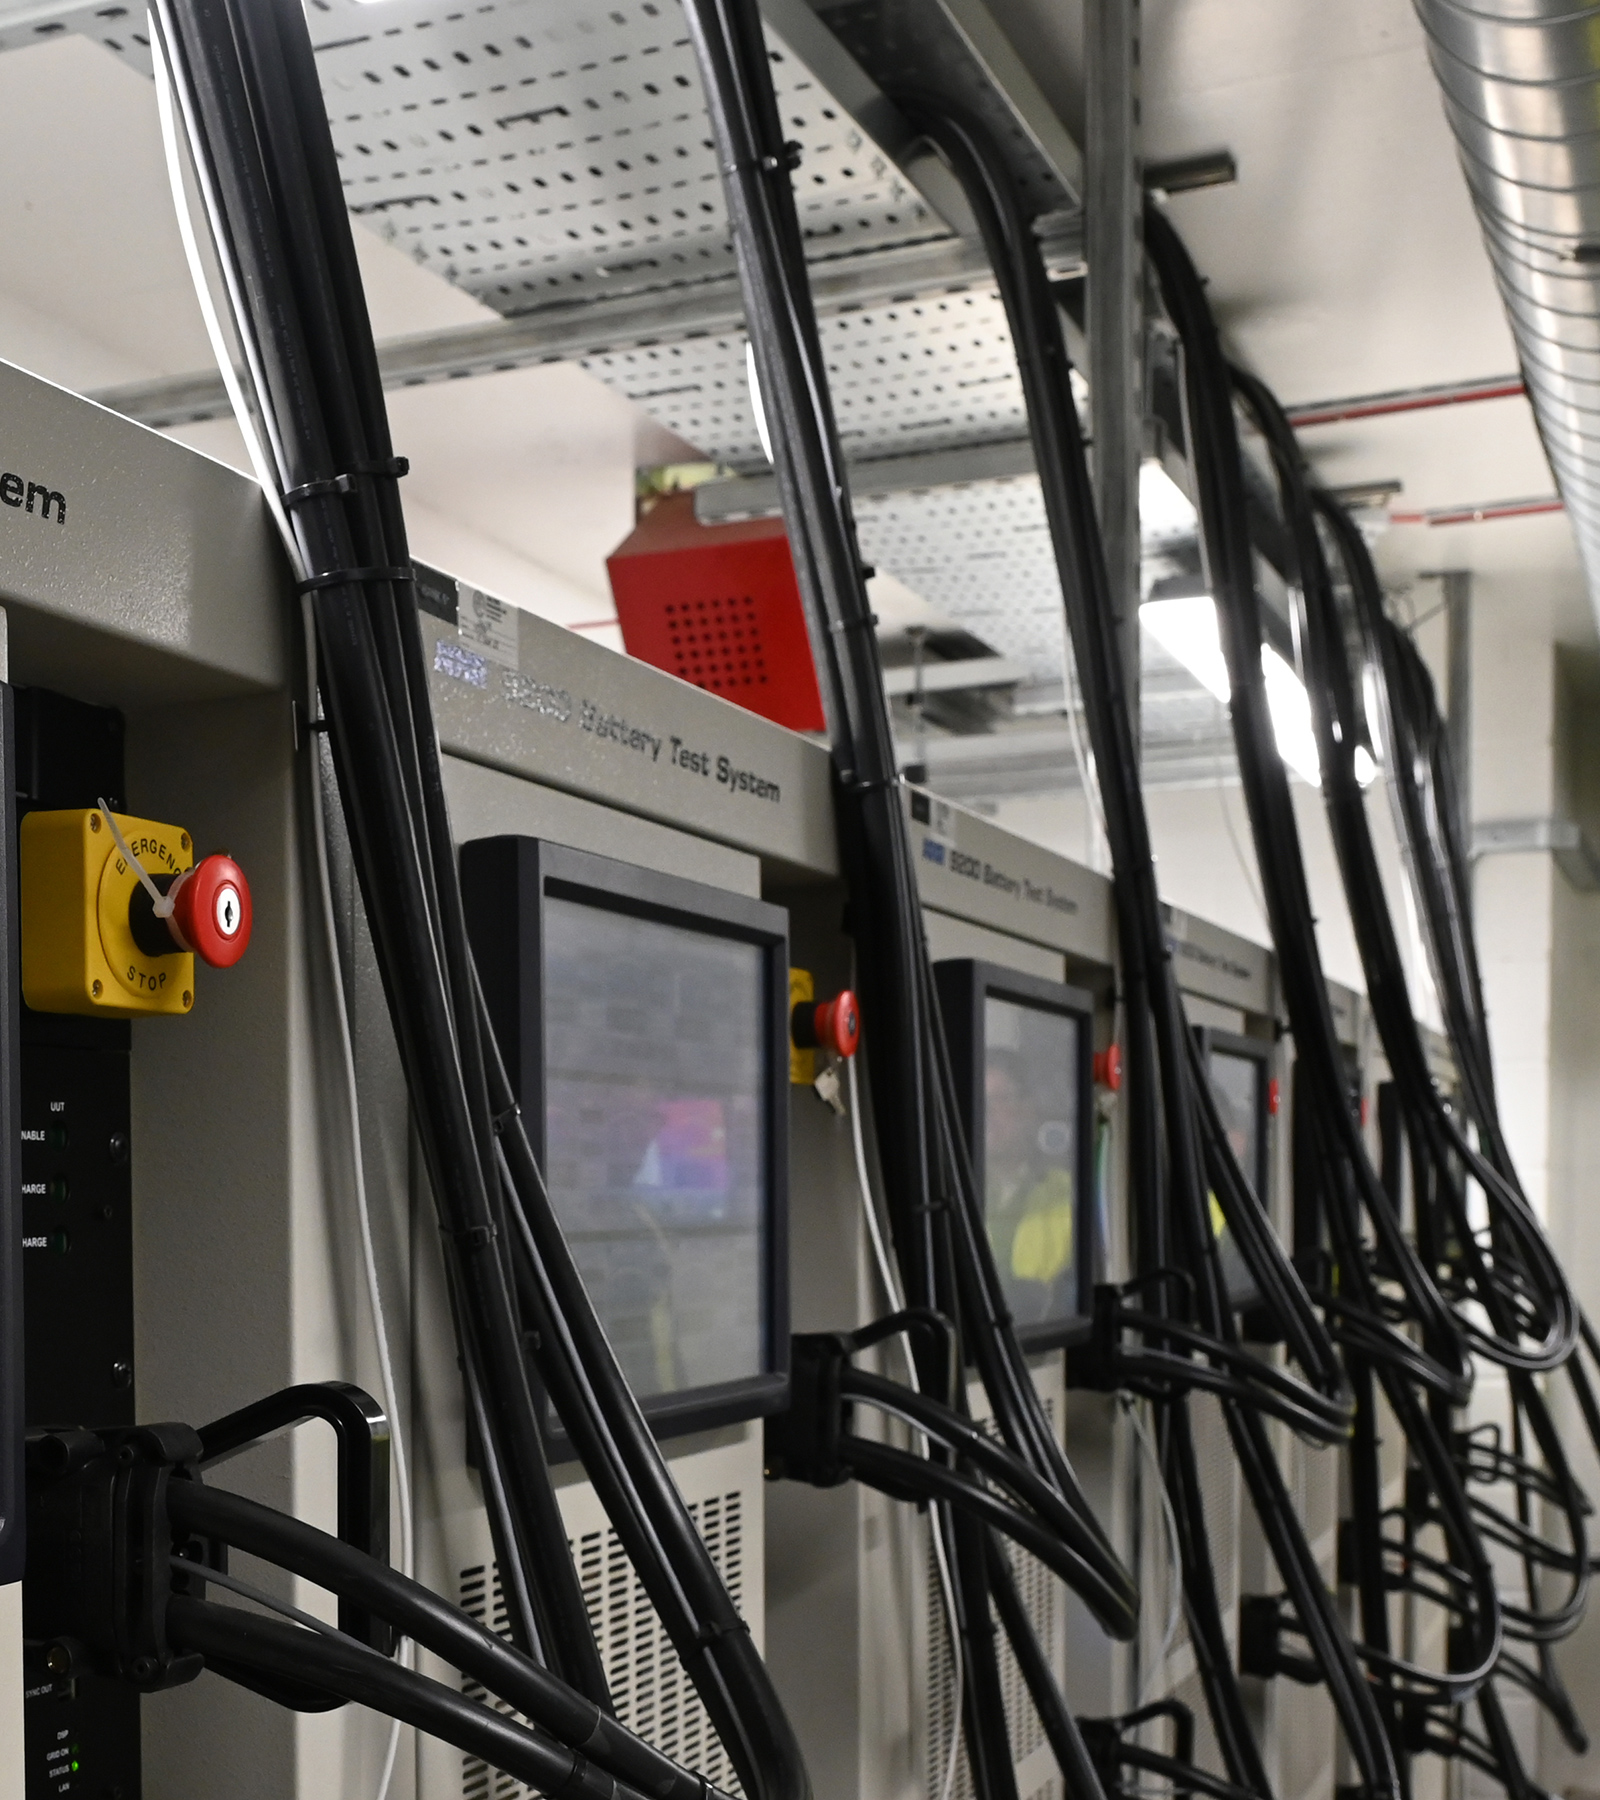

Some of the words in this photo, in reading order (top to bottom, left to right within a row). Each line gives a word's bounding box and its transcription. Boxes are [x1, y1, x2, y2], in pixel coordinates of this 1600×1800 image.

[670, 735, 711, 777] Test
[716, 756, 781, 804] System
[116, 838, 195, 875] EERGEN
[127, 965, 167, 991] STOP
[50, 1101, 65, 1112] UUT
[25, 1687, 41, 1698] SYNC
[41, 1683, 53, 1694] OUT
[49, 1764, 70, 1778] STATUS
[58, 1782, 70, 1793] LAN
